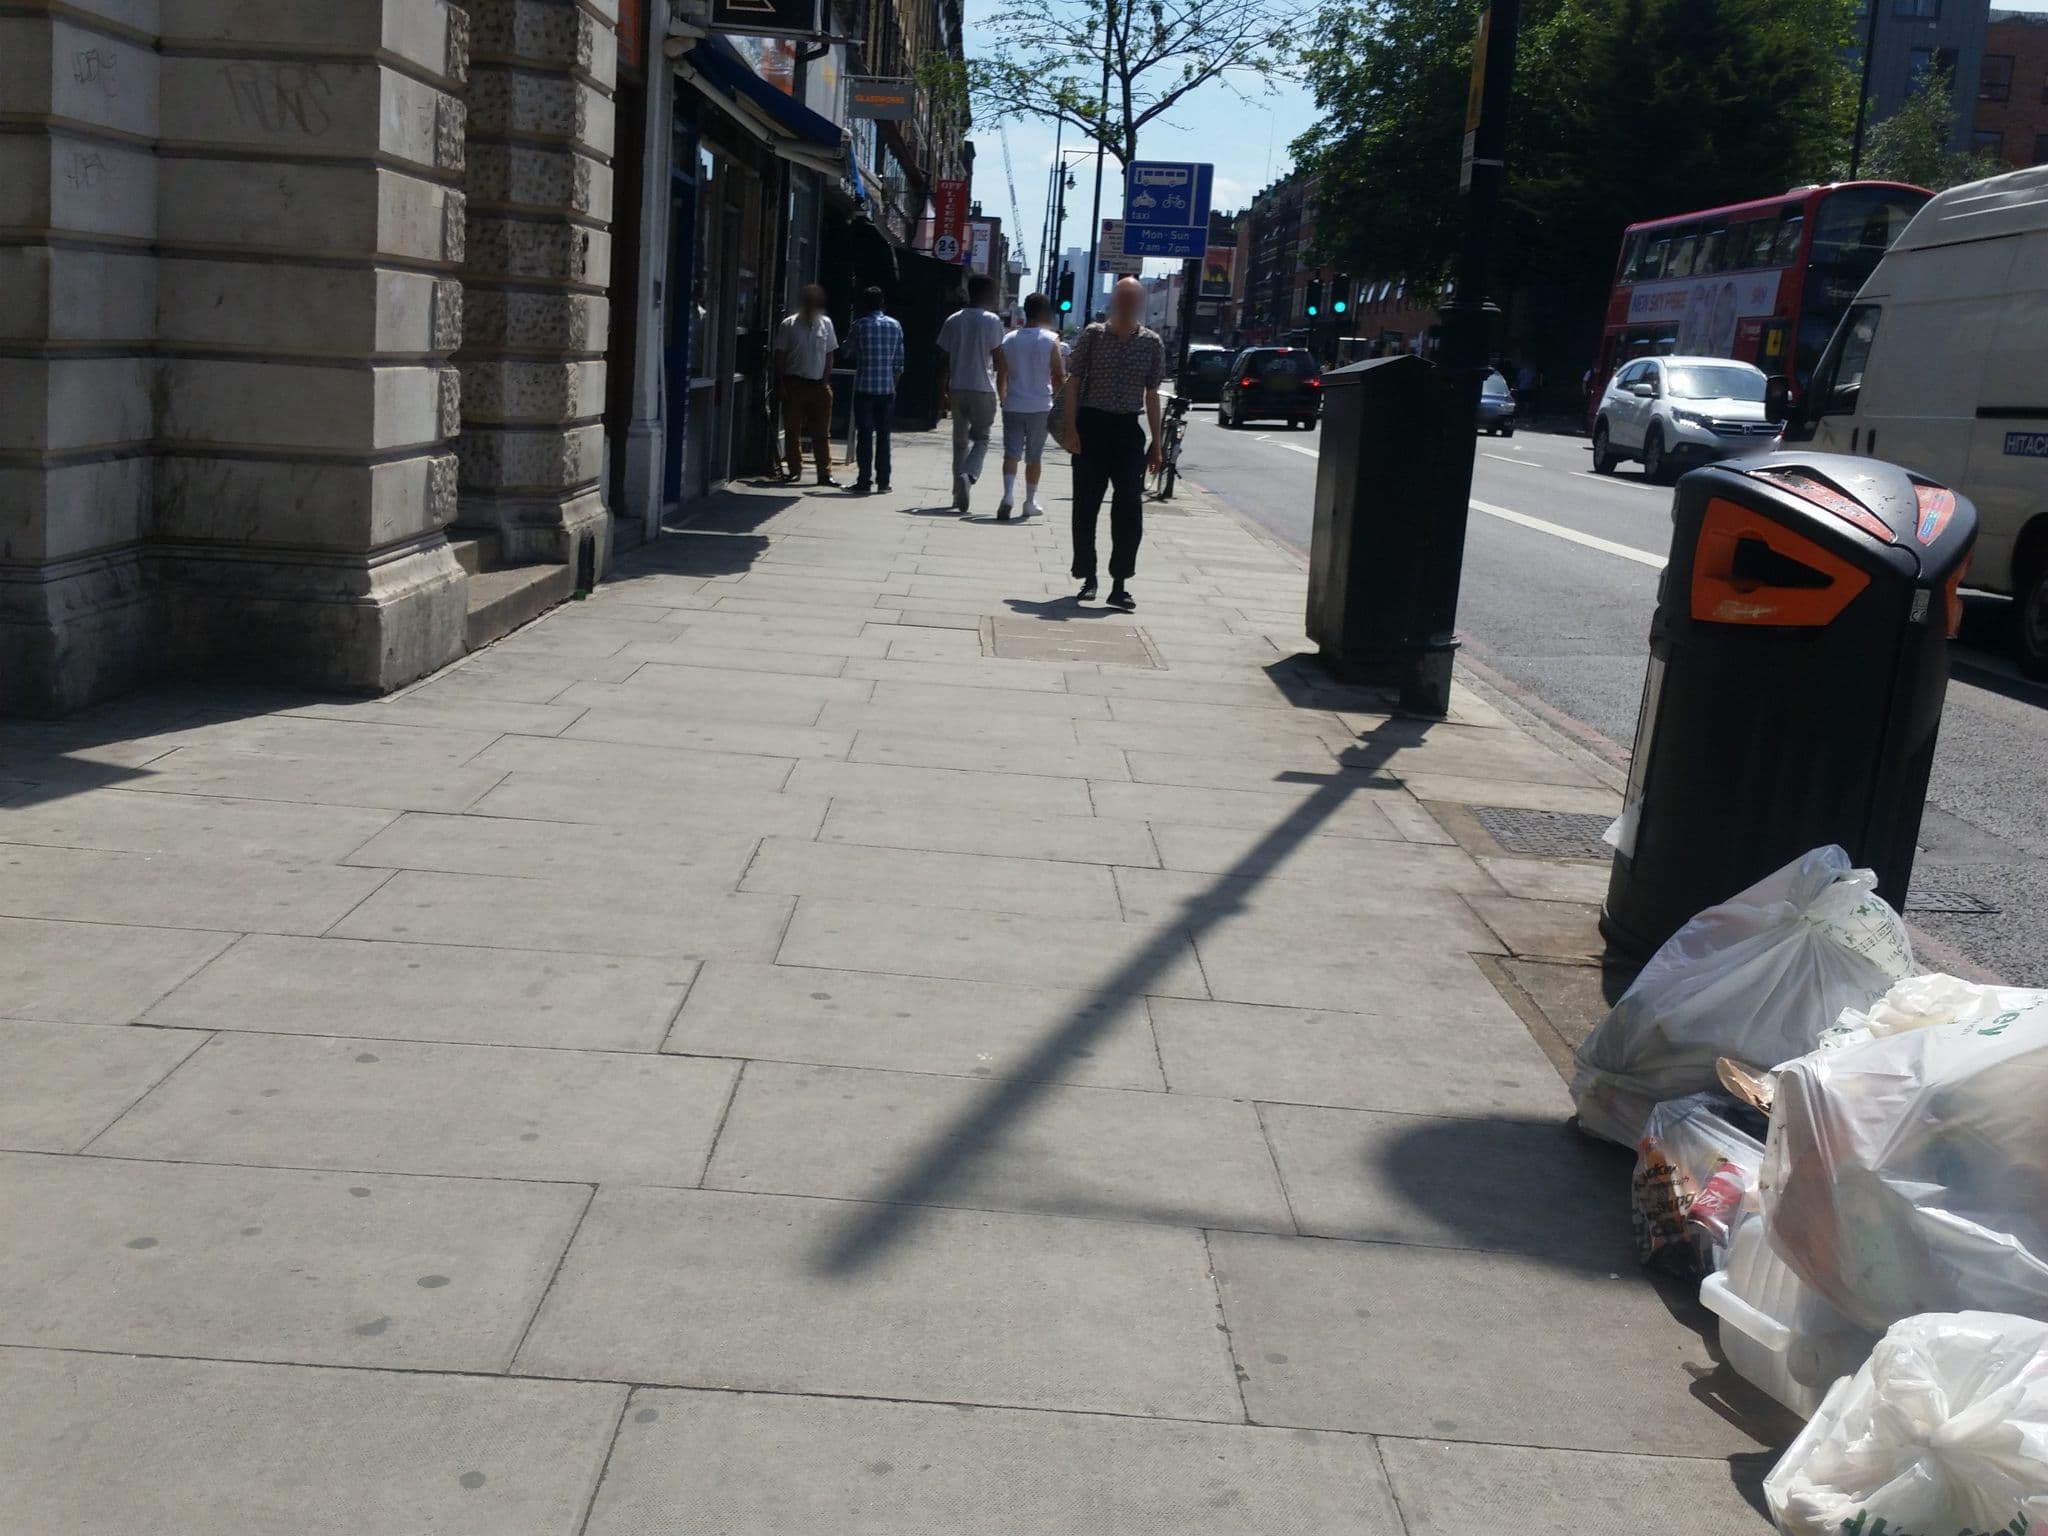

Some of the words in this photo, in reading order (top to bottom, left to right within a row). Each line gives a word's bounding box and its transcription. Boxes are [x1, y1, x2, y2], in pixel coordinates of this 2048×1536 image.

[941, 182, 962, 190] OFF
[1131, 211, 1150, 220] taxi
[1142, 230, 1163, 240] Mon
[1170, 231, 1190, 240] Sun
[938, 240, 956, 252] 24
